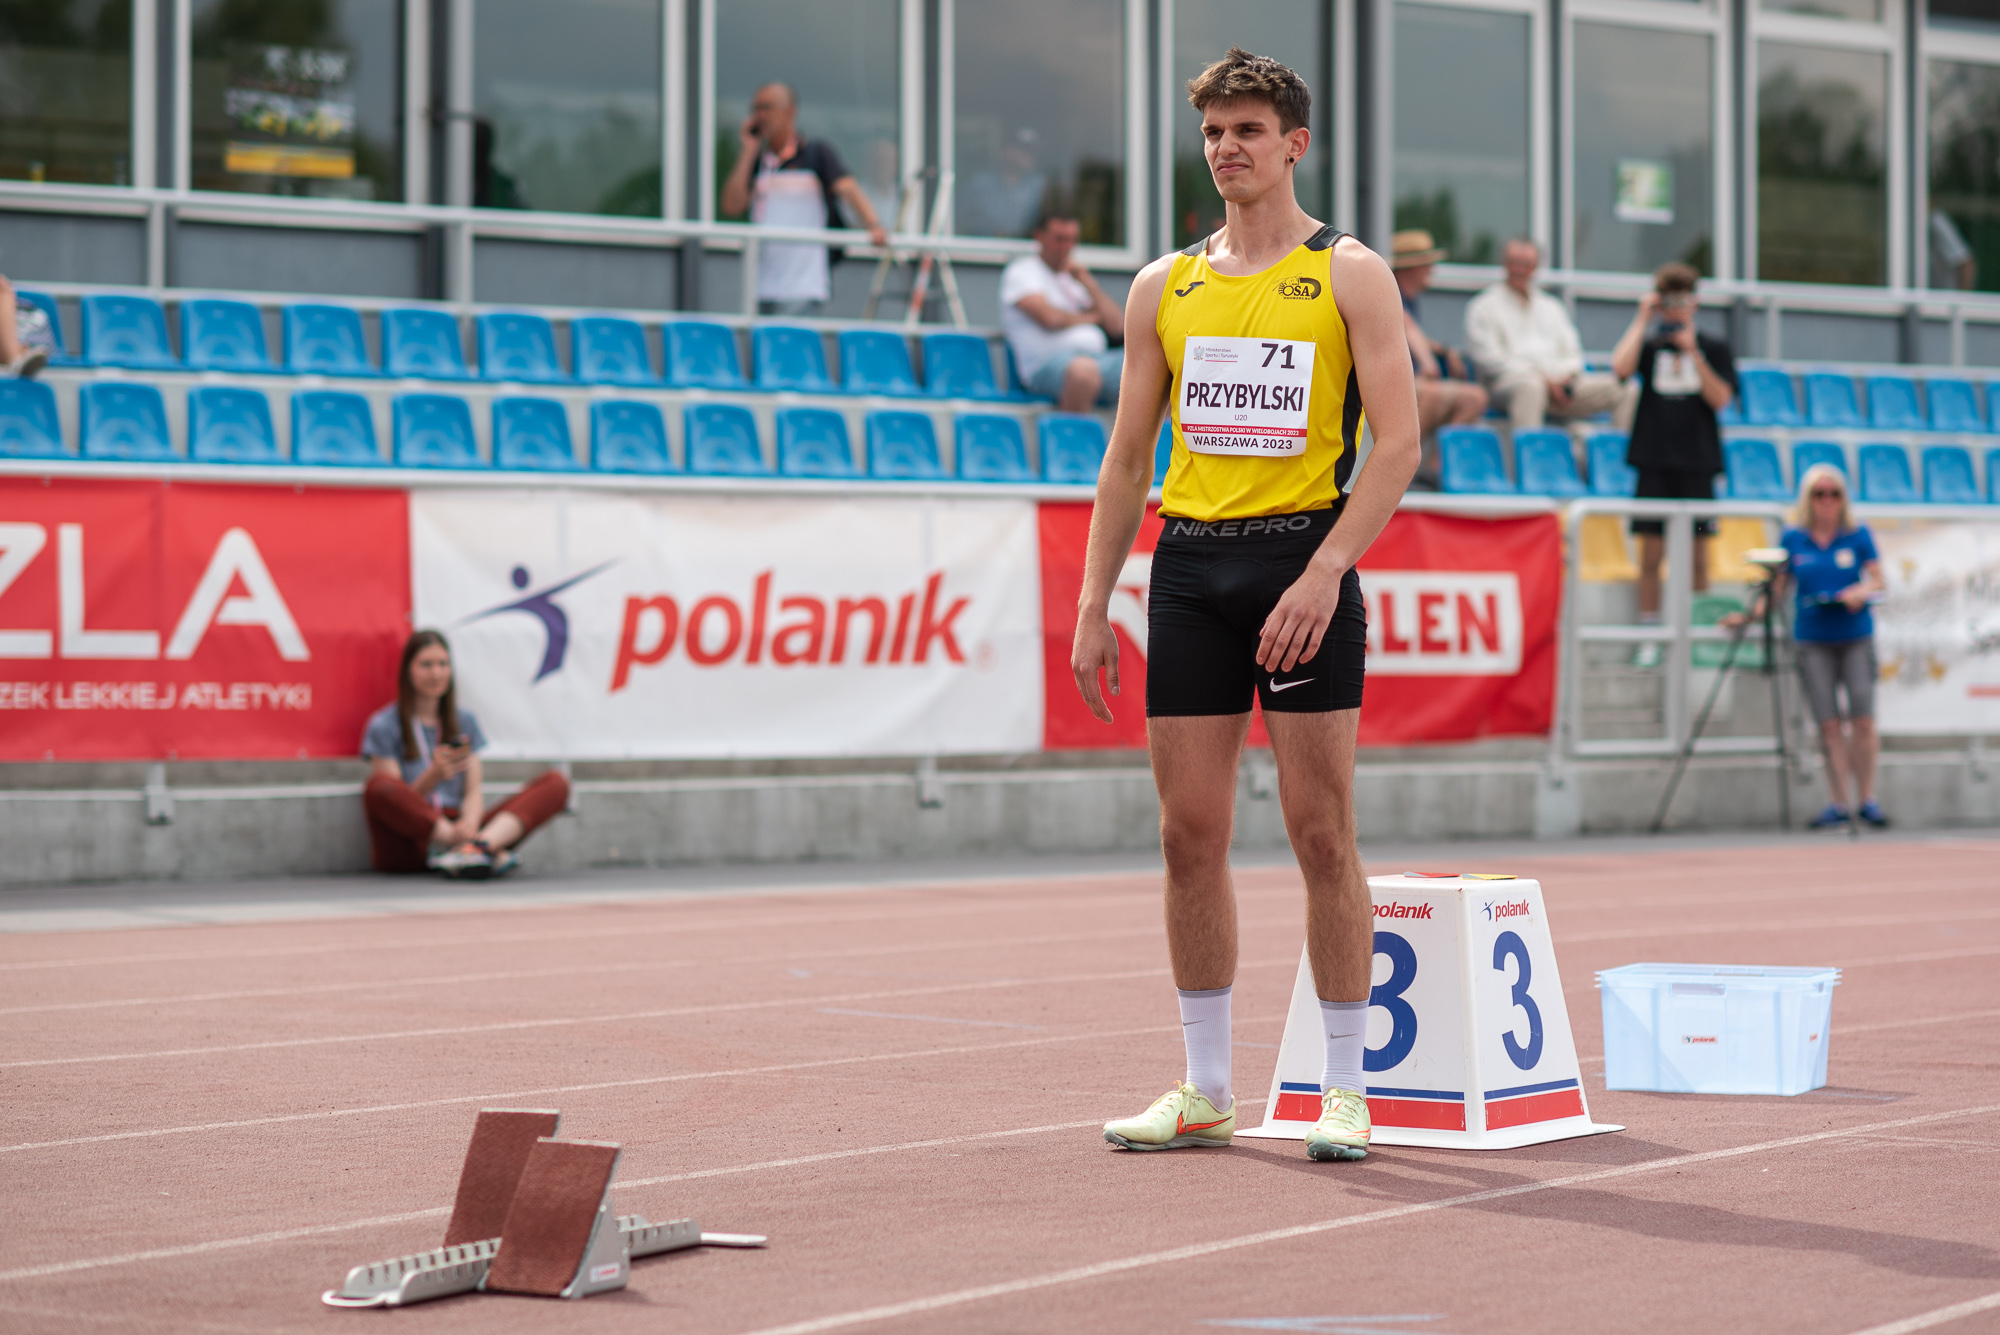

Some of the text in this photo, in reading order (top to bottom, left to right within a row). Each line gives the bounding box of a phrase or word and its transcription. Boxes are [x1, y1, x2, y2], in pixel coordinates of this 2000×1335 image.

[1261, 342, 1295, 369] 71
[1186, 382, 1304, 412] PRZYBYLSKI
[1192, 435, 1293, 450] WARSZAWA 2023
[1172, 515, 1311, 537] NIKE PRO
[607, 567, 972, 694] polanik
[1364, 592, 1501, 655] LEN
[54, 681, 177, 710] LEKKIEJ
[180, 681, 312, 711] ATLETYKI
[1495, 899, 1530, 922] polanik
[1362, 931, 1418, 1073] 3
[1493, 930, 1544, 1071] 3
